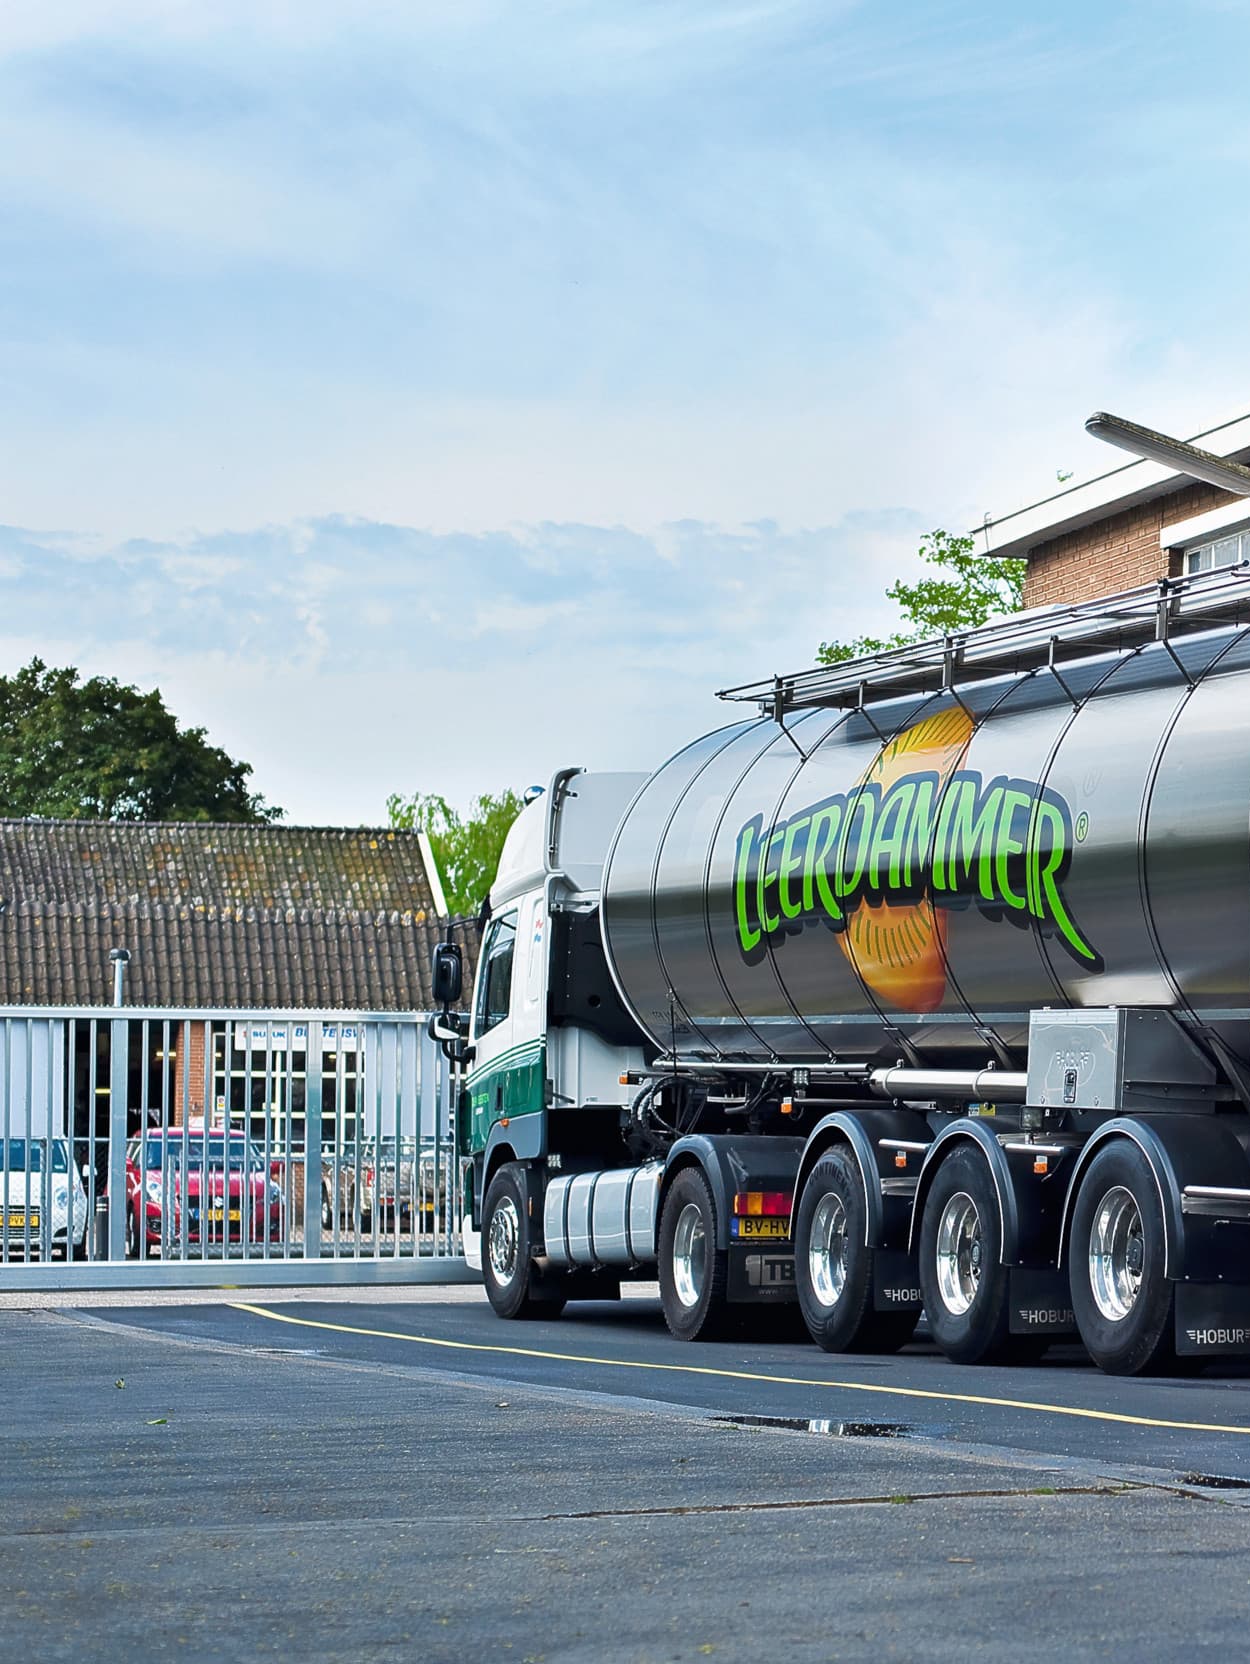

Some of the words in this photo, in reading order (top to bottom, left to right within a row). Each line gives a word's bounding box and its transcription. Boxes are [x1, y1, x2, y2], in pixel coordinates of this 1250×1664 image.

[734, 780, 1096, 961] LEERDAMMER
[744, 1220, 789, 1234] BV-HV
[1196, 1328, 1245, 1345] HOBUR
